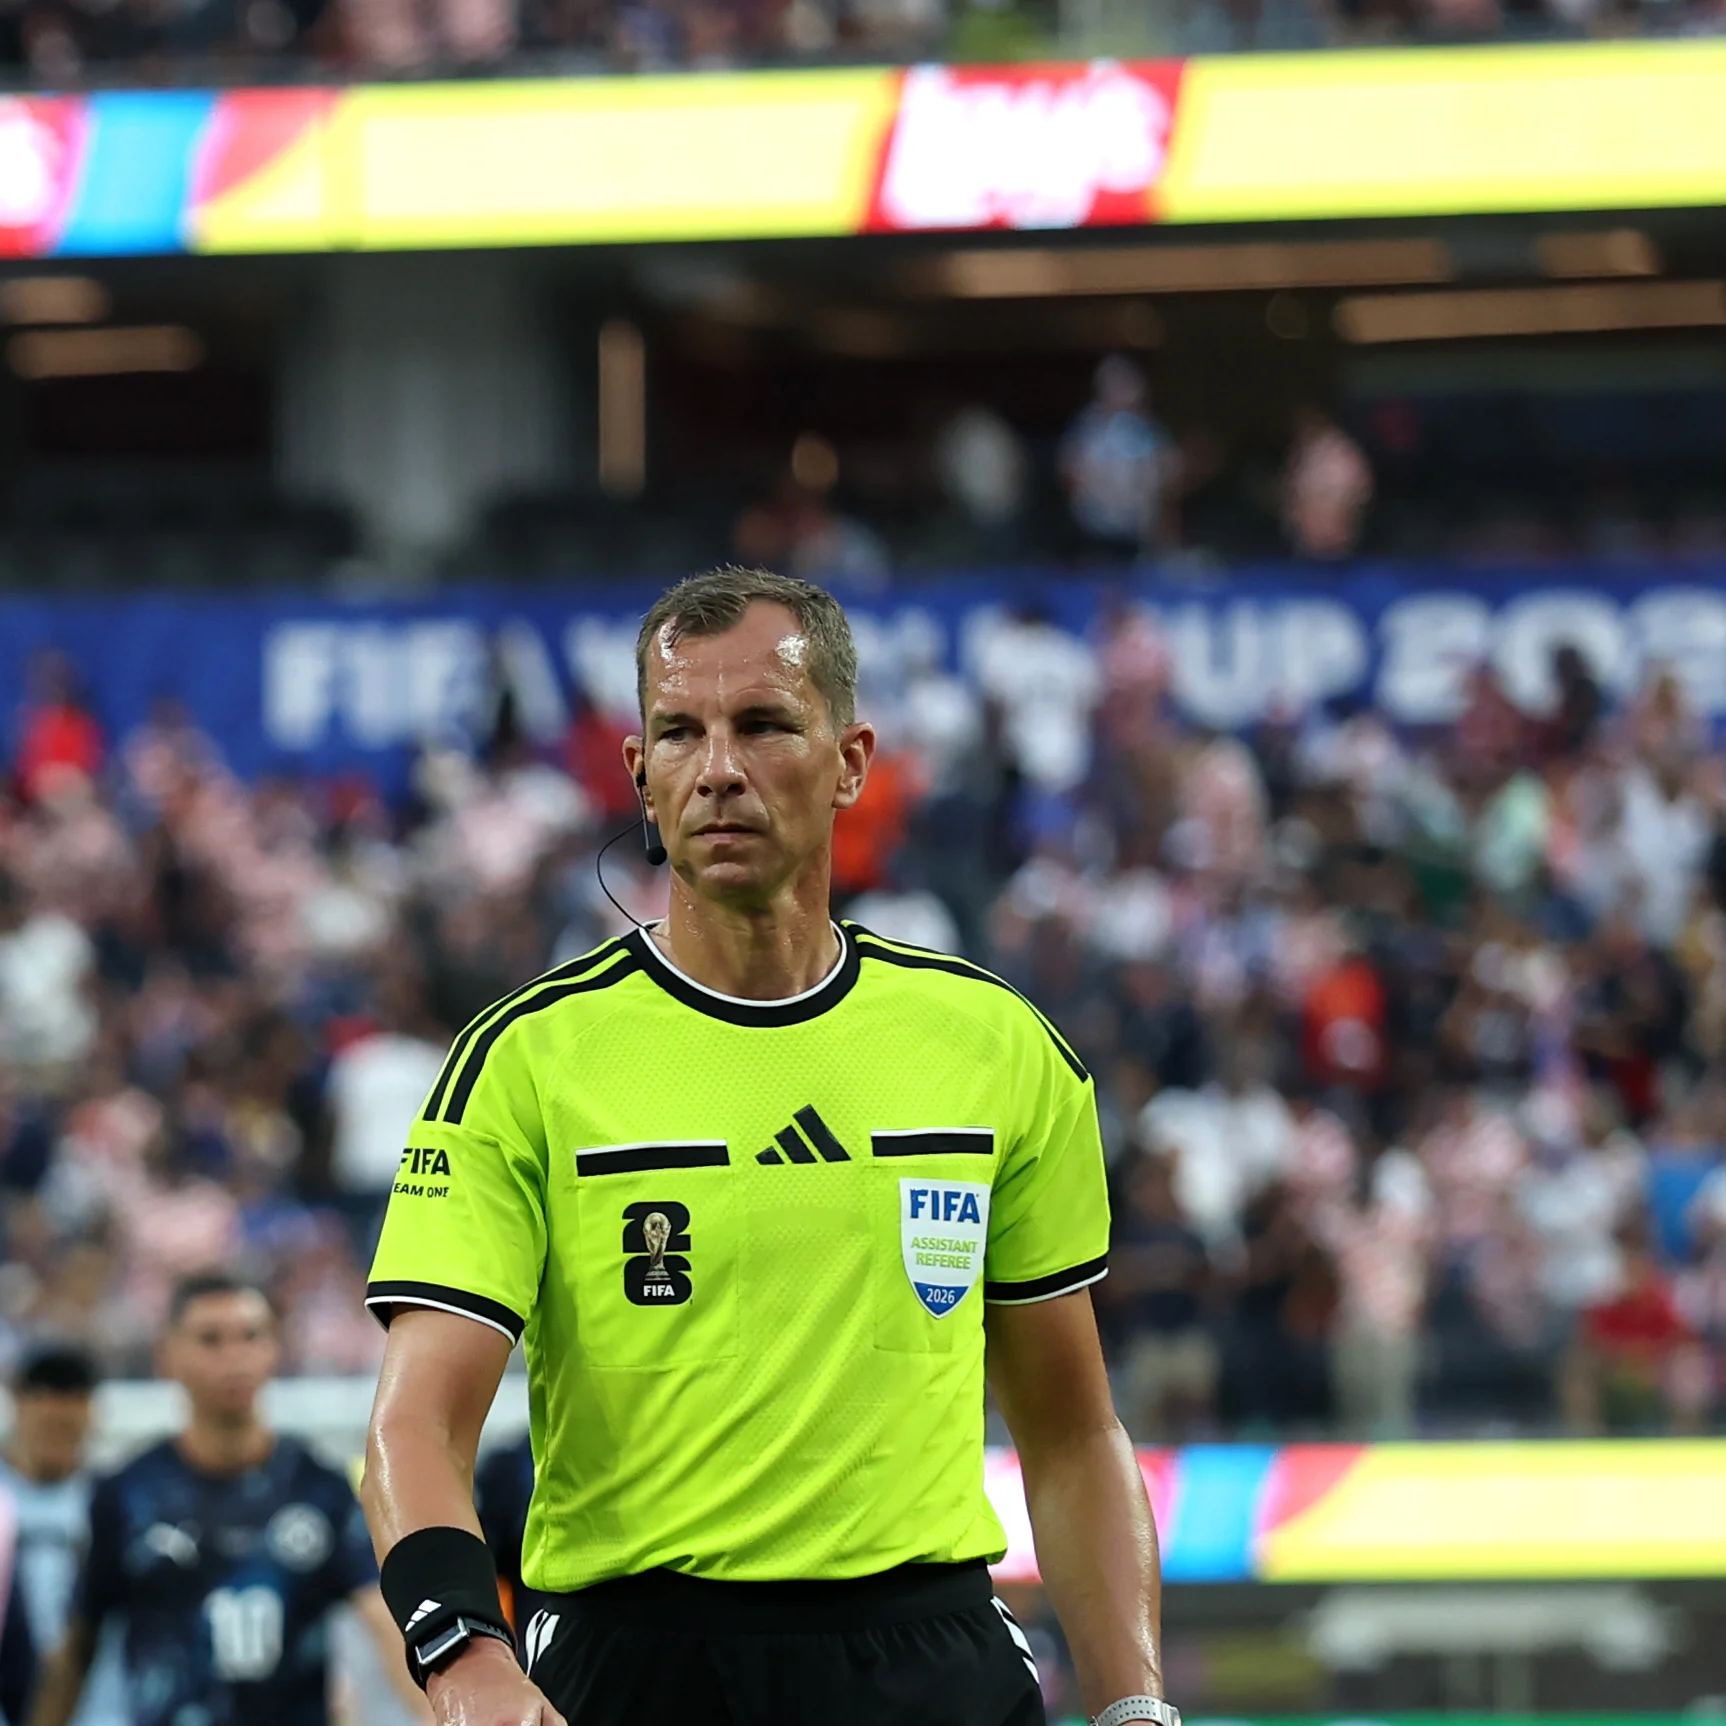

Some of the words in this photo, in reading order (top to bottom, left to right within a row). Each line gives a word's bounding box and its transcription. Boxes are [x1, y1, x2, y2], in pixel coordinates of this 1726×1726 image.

[1374, 588, 1726, 722] 202
[393, 1183, 424, 1196] EAM
[427, 1186, 449, 1198] ONE
[910, 1188, 980, 1224] FIFA
[911, 1237, 978, 1254] ASSISTANT
[916, 1252, 971, 1269] REFEREE
[643, 1284, 675, 1297] FIFA
[926, 1287, 956, 1304] 2026
[204, 1585, 284, 1682] 10
